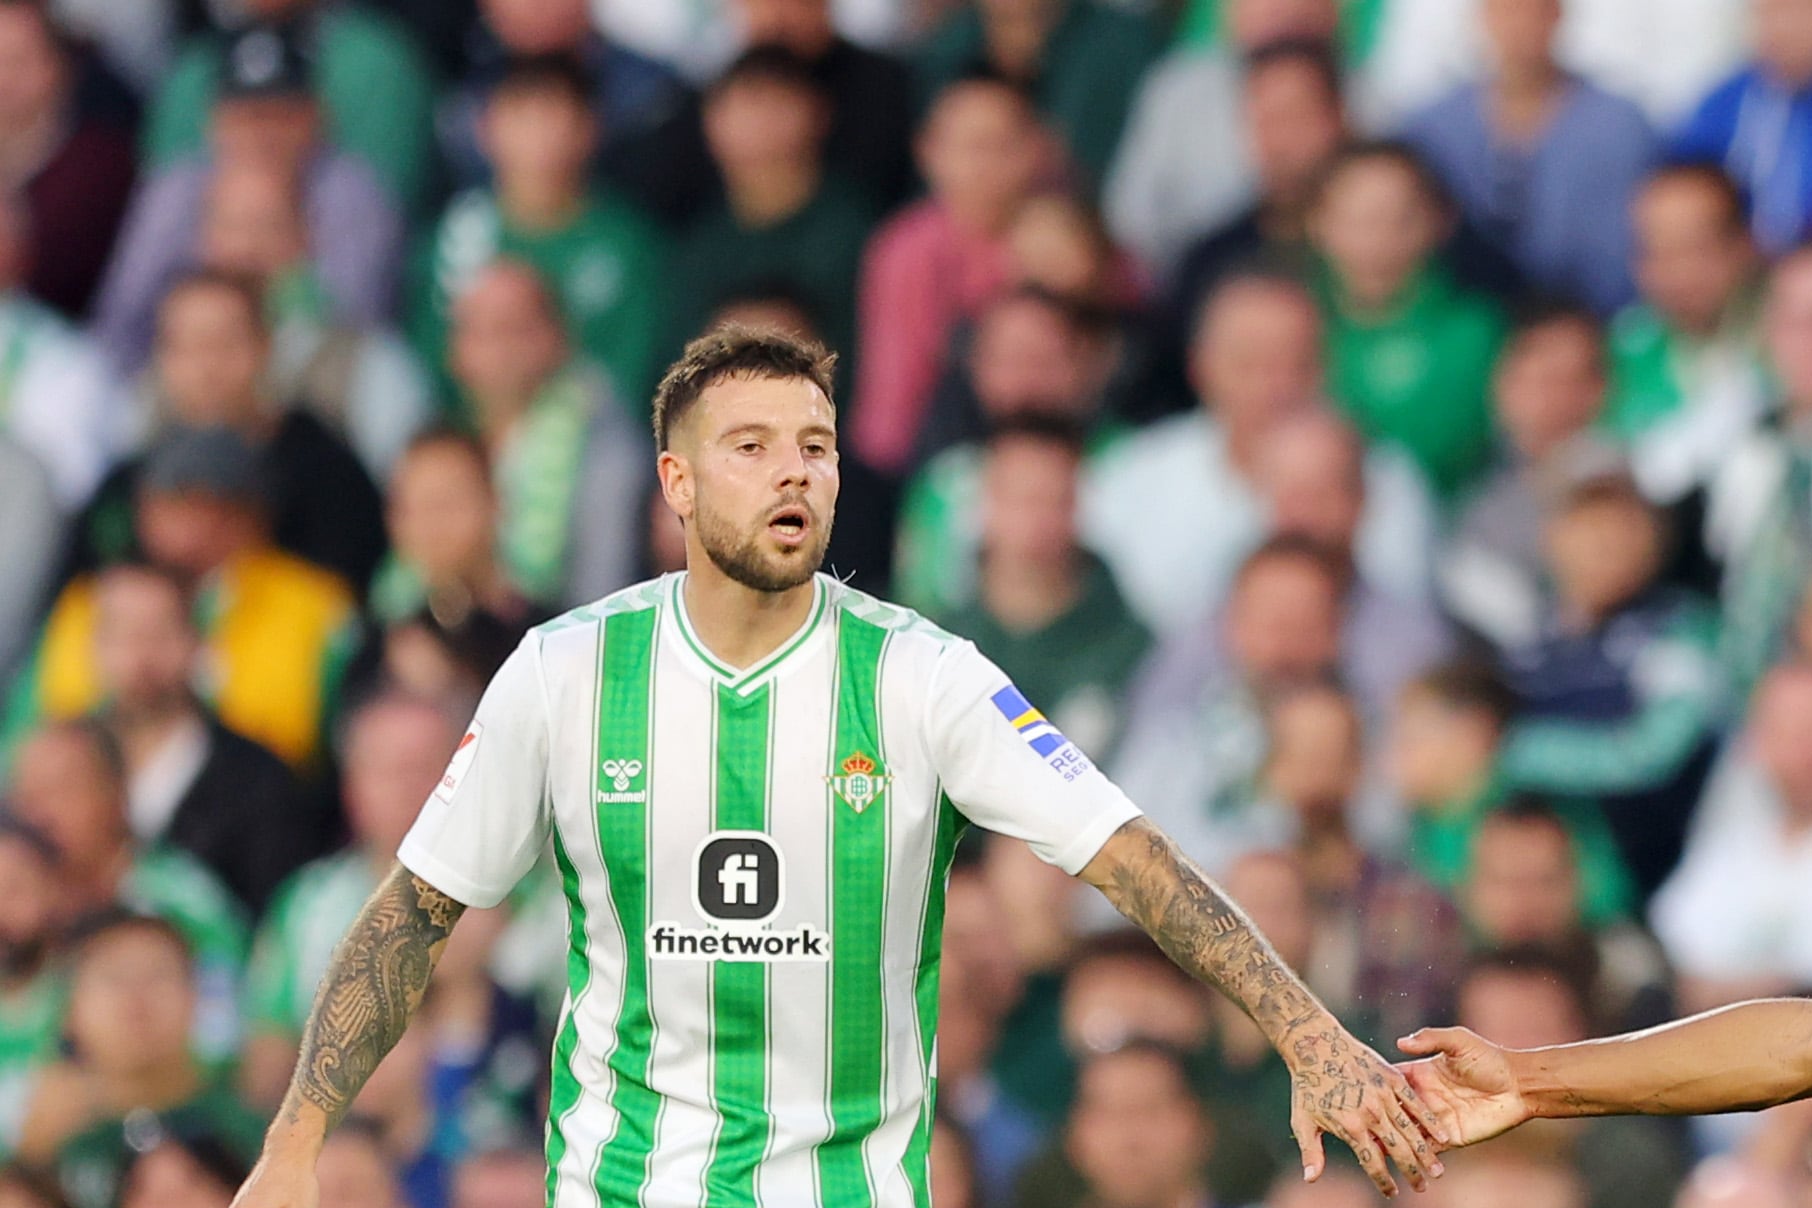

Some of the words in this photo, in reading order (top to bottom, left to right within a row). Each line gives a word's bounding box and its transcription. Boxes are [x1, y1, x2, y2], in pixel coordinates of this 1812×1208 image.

[1050, 747, 1081, 773] RE
[597, 789, 646, 803] hummel
[718, 853, 758, 905] fi
[652, 927, 822, 955] finetwork
